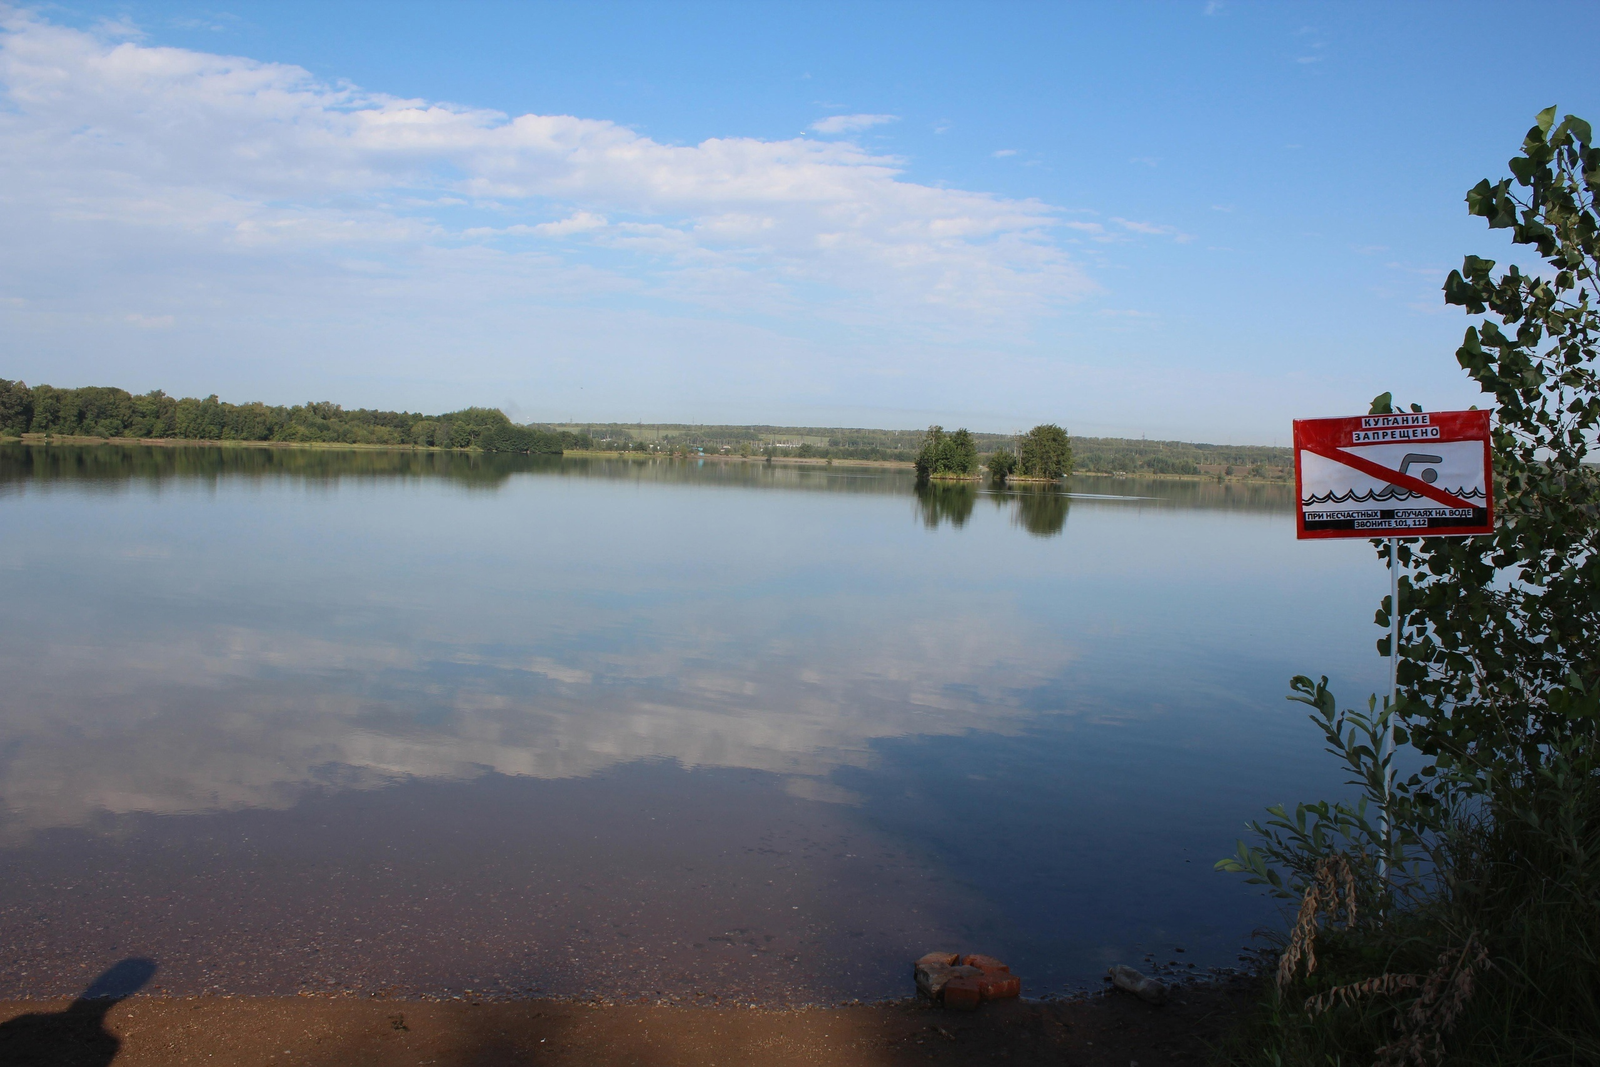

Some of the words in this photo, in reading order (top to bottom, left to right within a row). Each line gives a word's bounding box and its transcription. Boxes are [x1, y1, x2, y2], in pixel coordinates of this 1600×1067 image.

[1364, 415, 1428, 427] КУПАНИЕ
[1354, 428, 1439, 441] ЗАПРЕЩЕНО
[1325, 511, 1379, 520] НЕСЧАСТНЫХ
[1395, 510, 1434, 518] СЛУЧАЯХ
[1448, 509, 1472, 517] ВОДЕ
[1355, 520, 1393, 528] ЗВОНИТЕ
[1393, 519, 1411, 528] 101,
